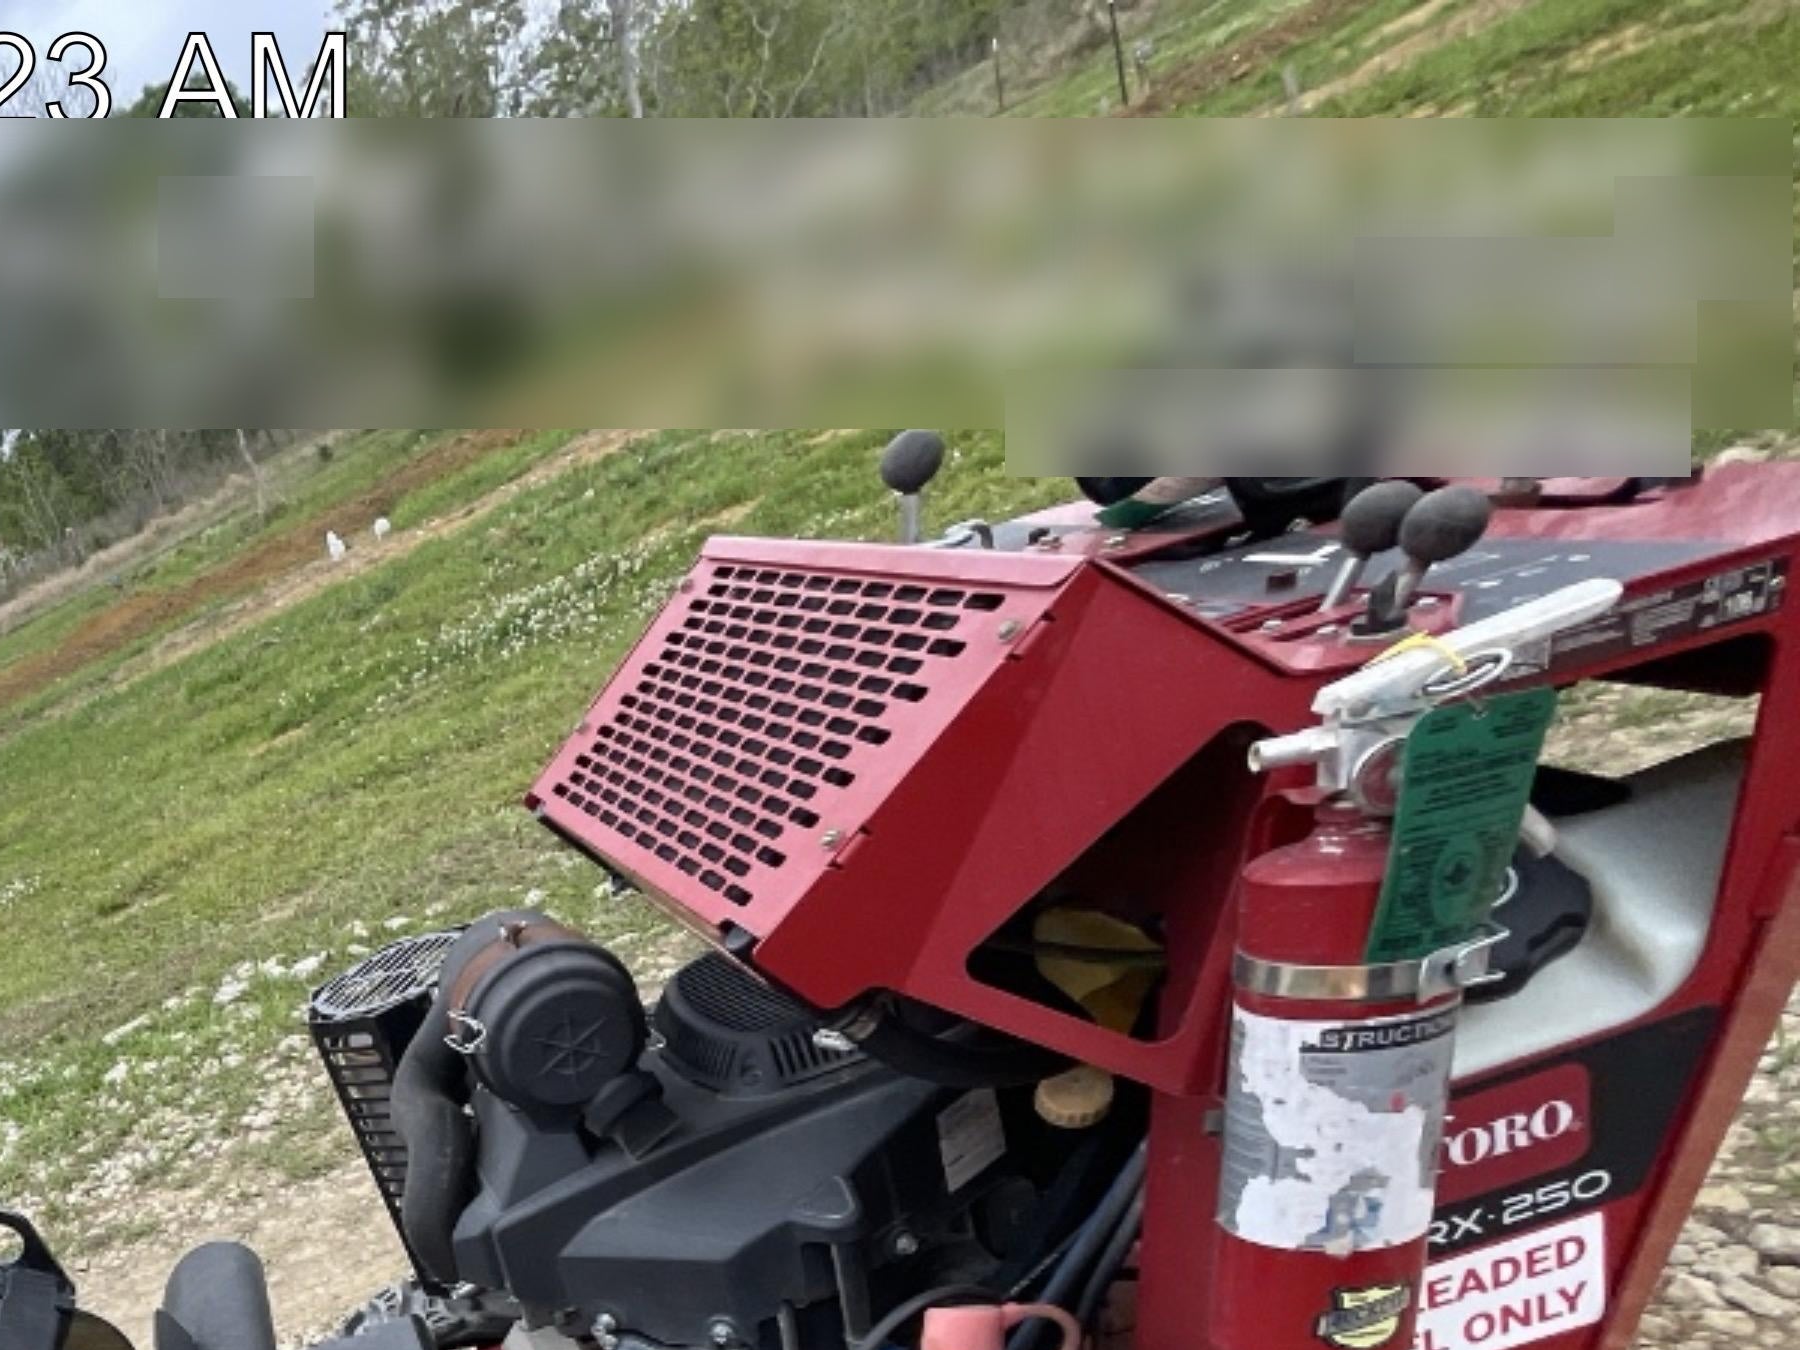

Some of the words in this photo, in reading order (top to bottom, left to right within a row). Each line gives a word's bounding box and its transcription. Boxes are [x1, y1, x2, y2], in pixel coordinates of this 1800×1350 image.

[1441, 1100, 1574, 1173] ORO
[1419, 1236, 1586, 1312] EADED
[1463, 1281, 1587, 1343] ONLY
